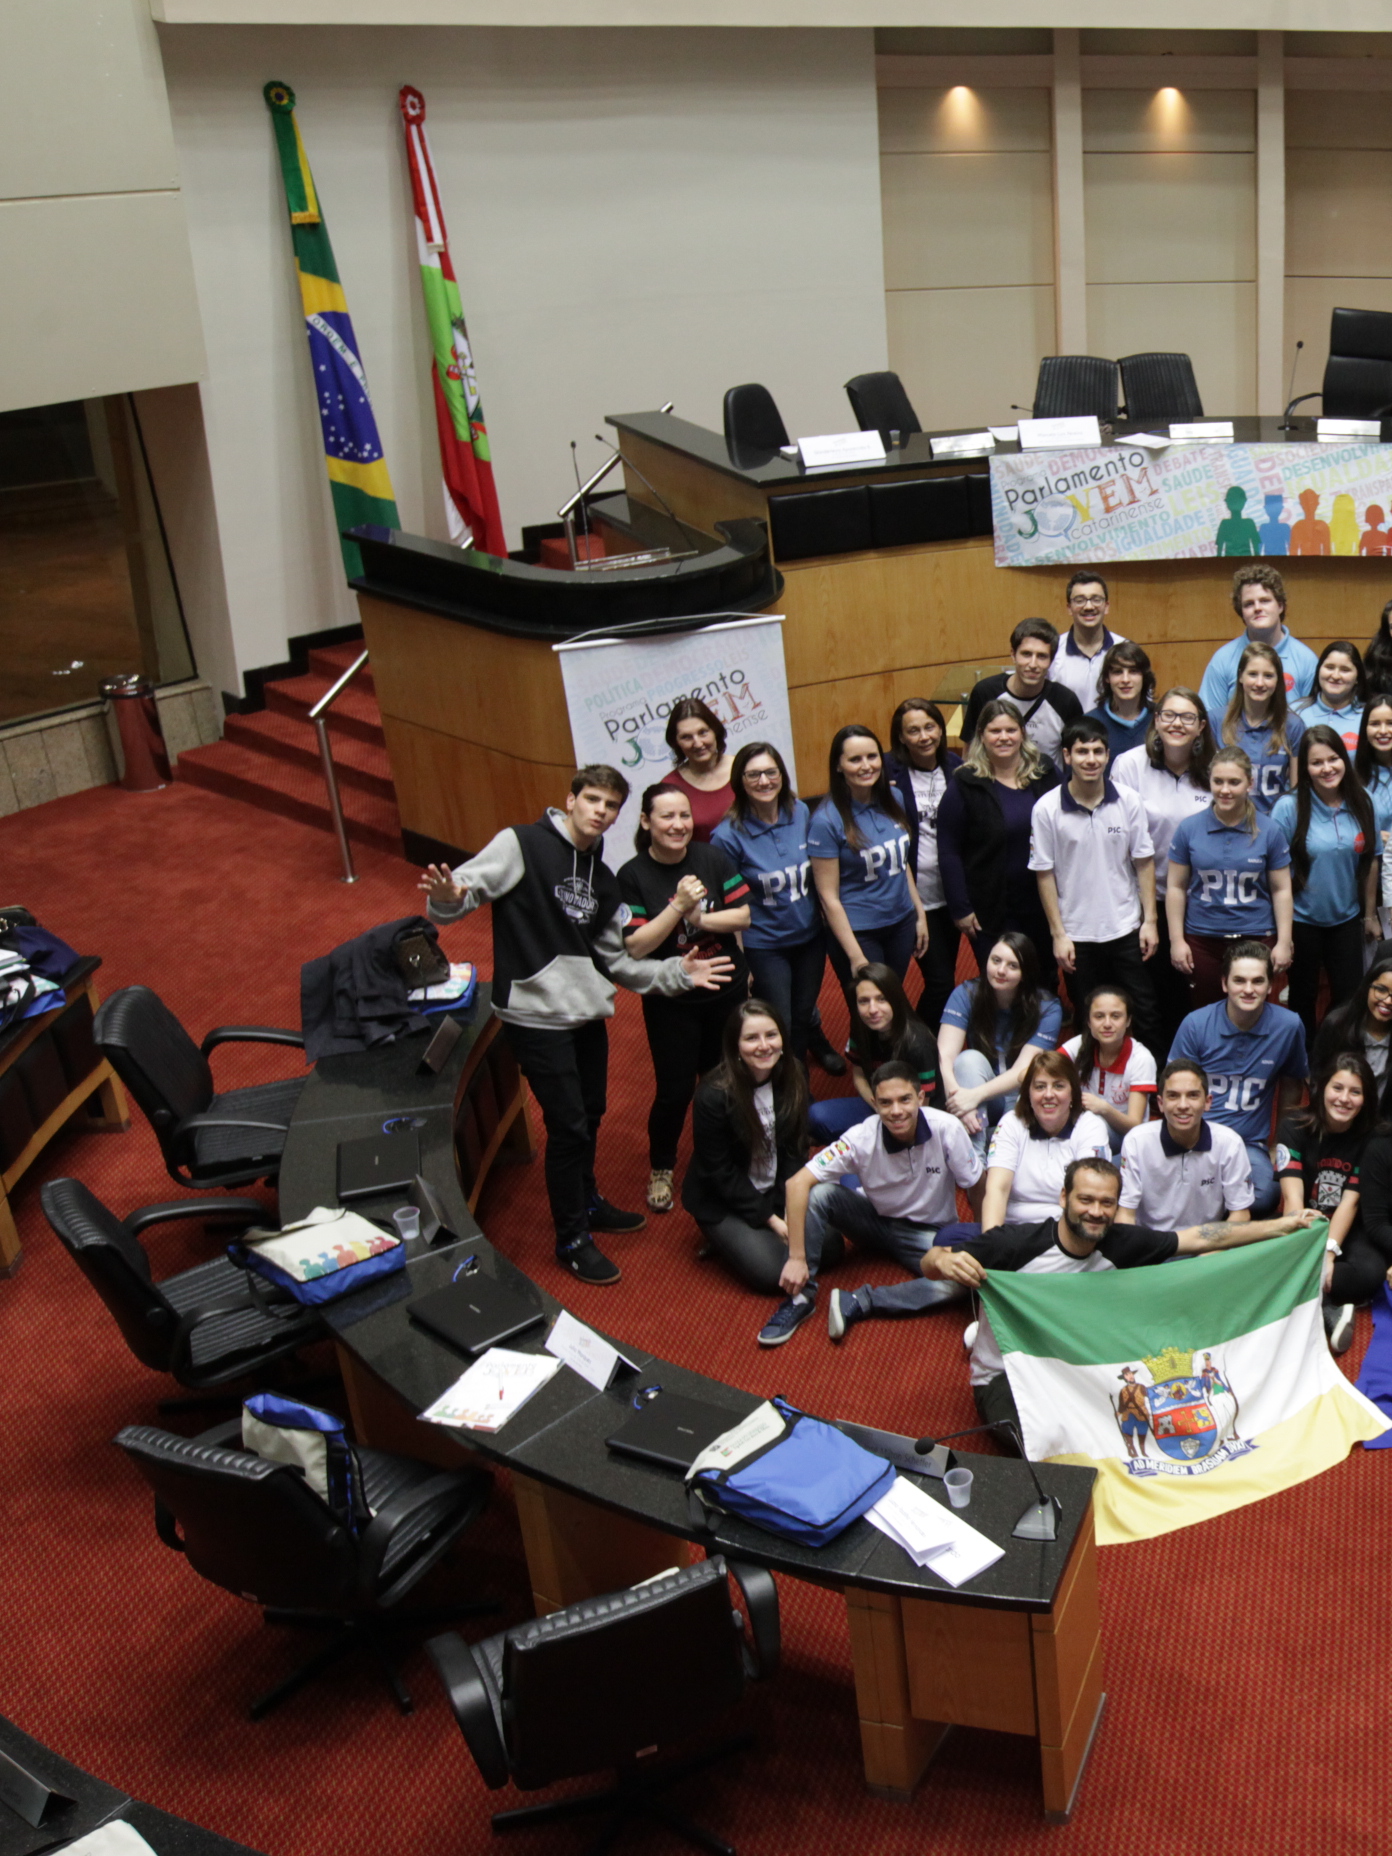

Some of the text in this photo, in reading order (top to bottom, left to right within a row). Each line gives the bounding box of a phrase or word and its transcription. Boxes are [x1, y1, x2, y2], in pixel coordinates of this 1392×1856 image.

[1153, 447, 1209, 477] DEBATE
[1161, 463, 1214, 494] SAÚDE
[1004, 452, 1145, 512] Parlamento
[1070, 496, 1166, 540] catarinense
[1114, 510, 1206, 553] IGUALDADE
[1197, 869, 1261, 905] PIC
[1133, 1459, 1145, 1471] AD
[1145, 1459, 1189, 1475] MERIDIEM
